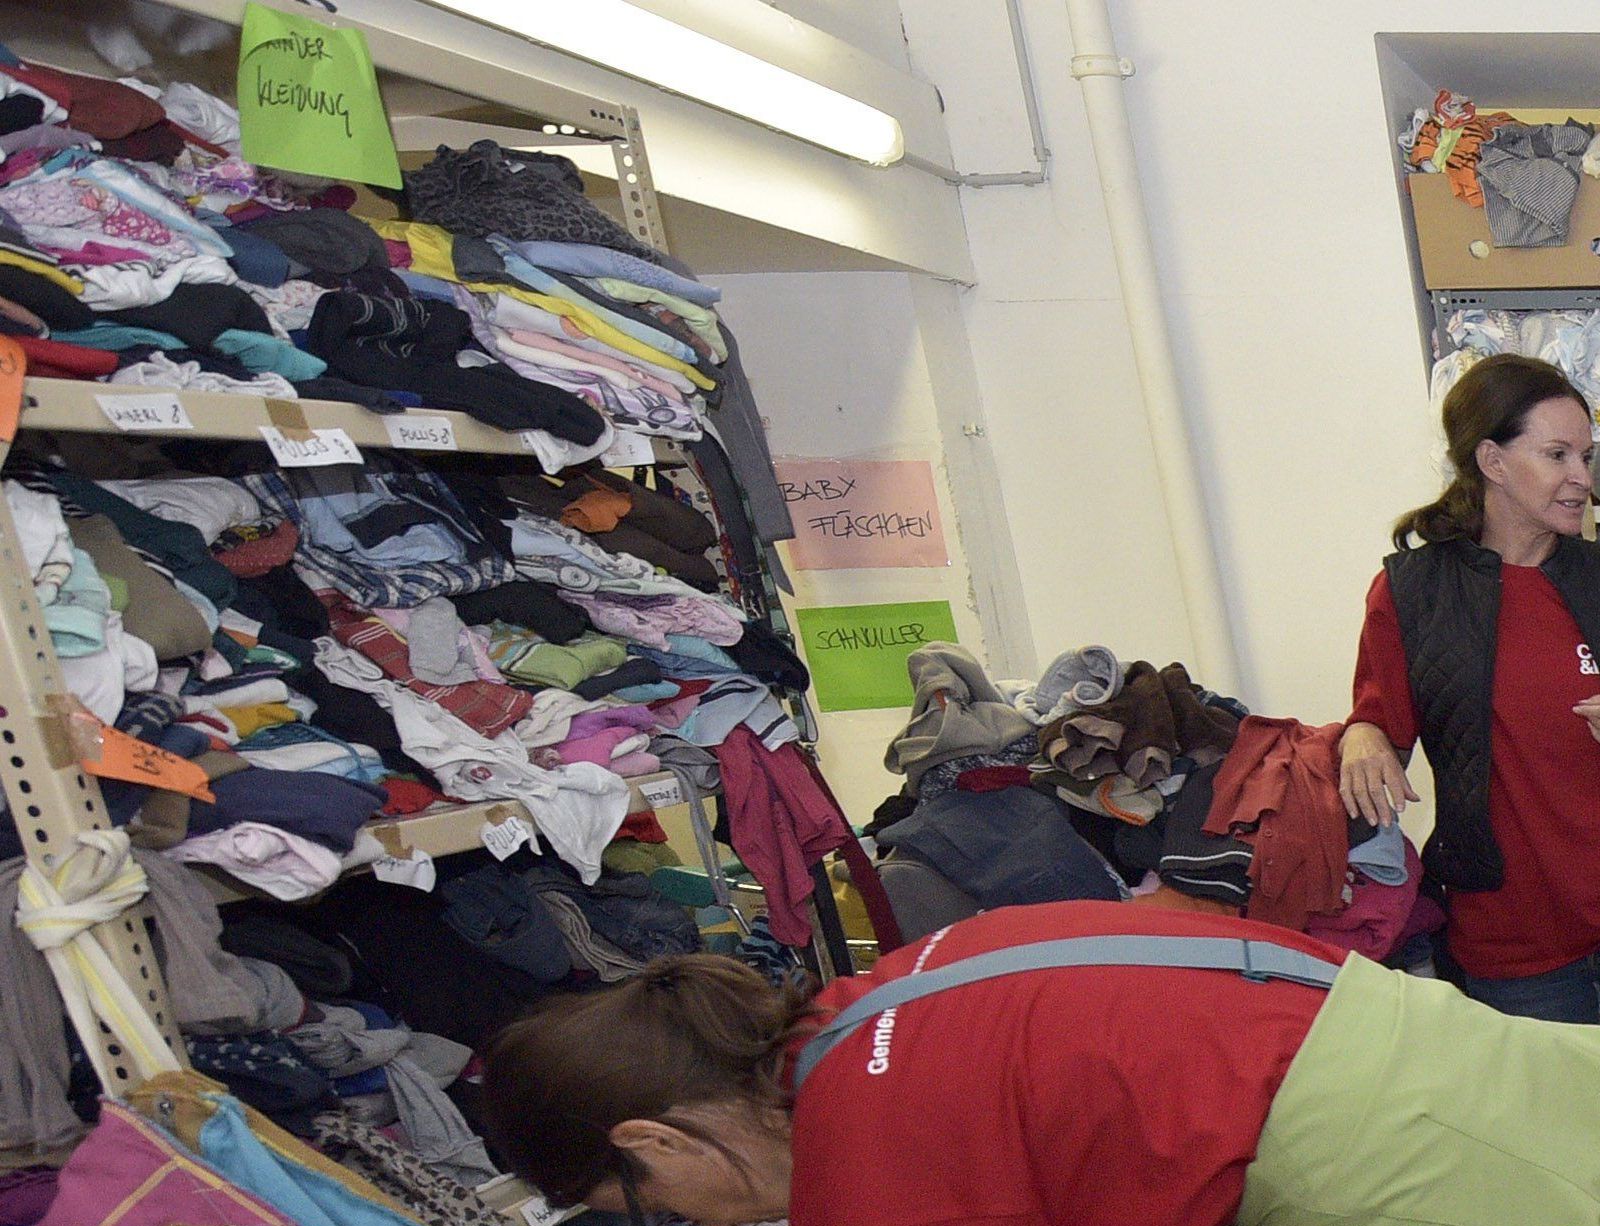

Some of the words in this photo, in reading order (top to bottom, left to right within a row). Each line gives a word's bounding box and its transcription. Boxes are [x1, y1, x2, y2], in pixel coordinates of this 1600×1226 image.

[778, 475, 857, 502] BABY
[815, 622, 932, 651] SCHNULLER
[1576, 643, 1593, 660] C
